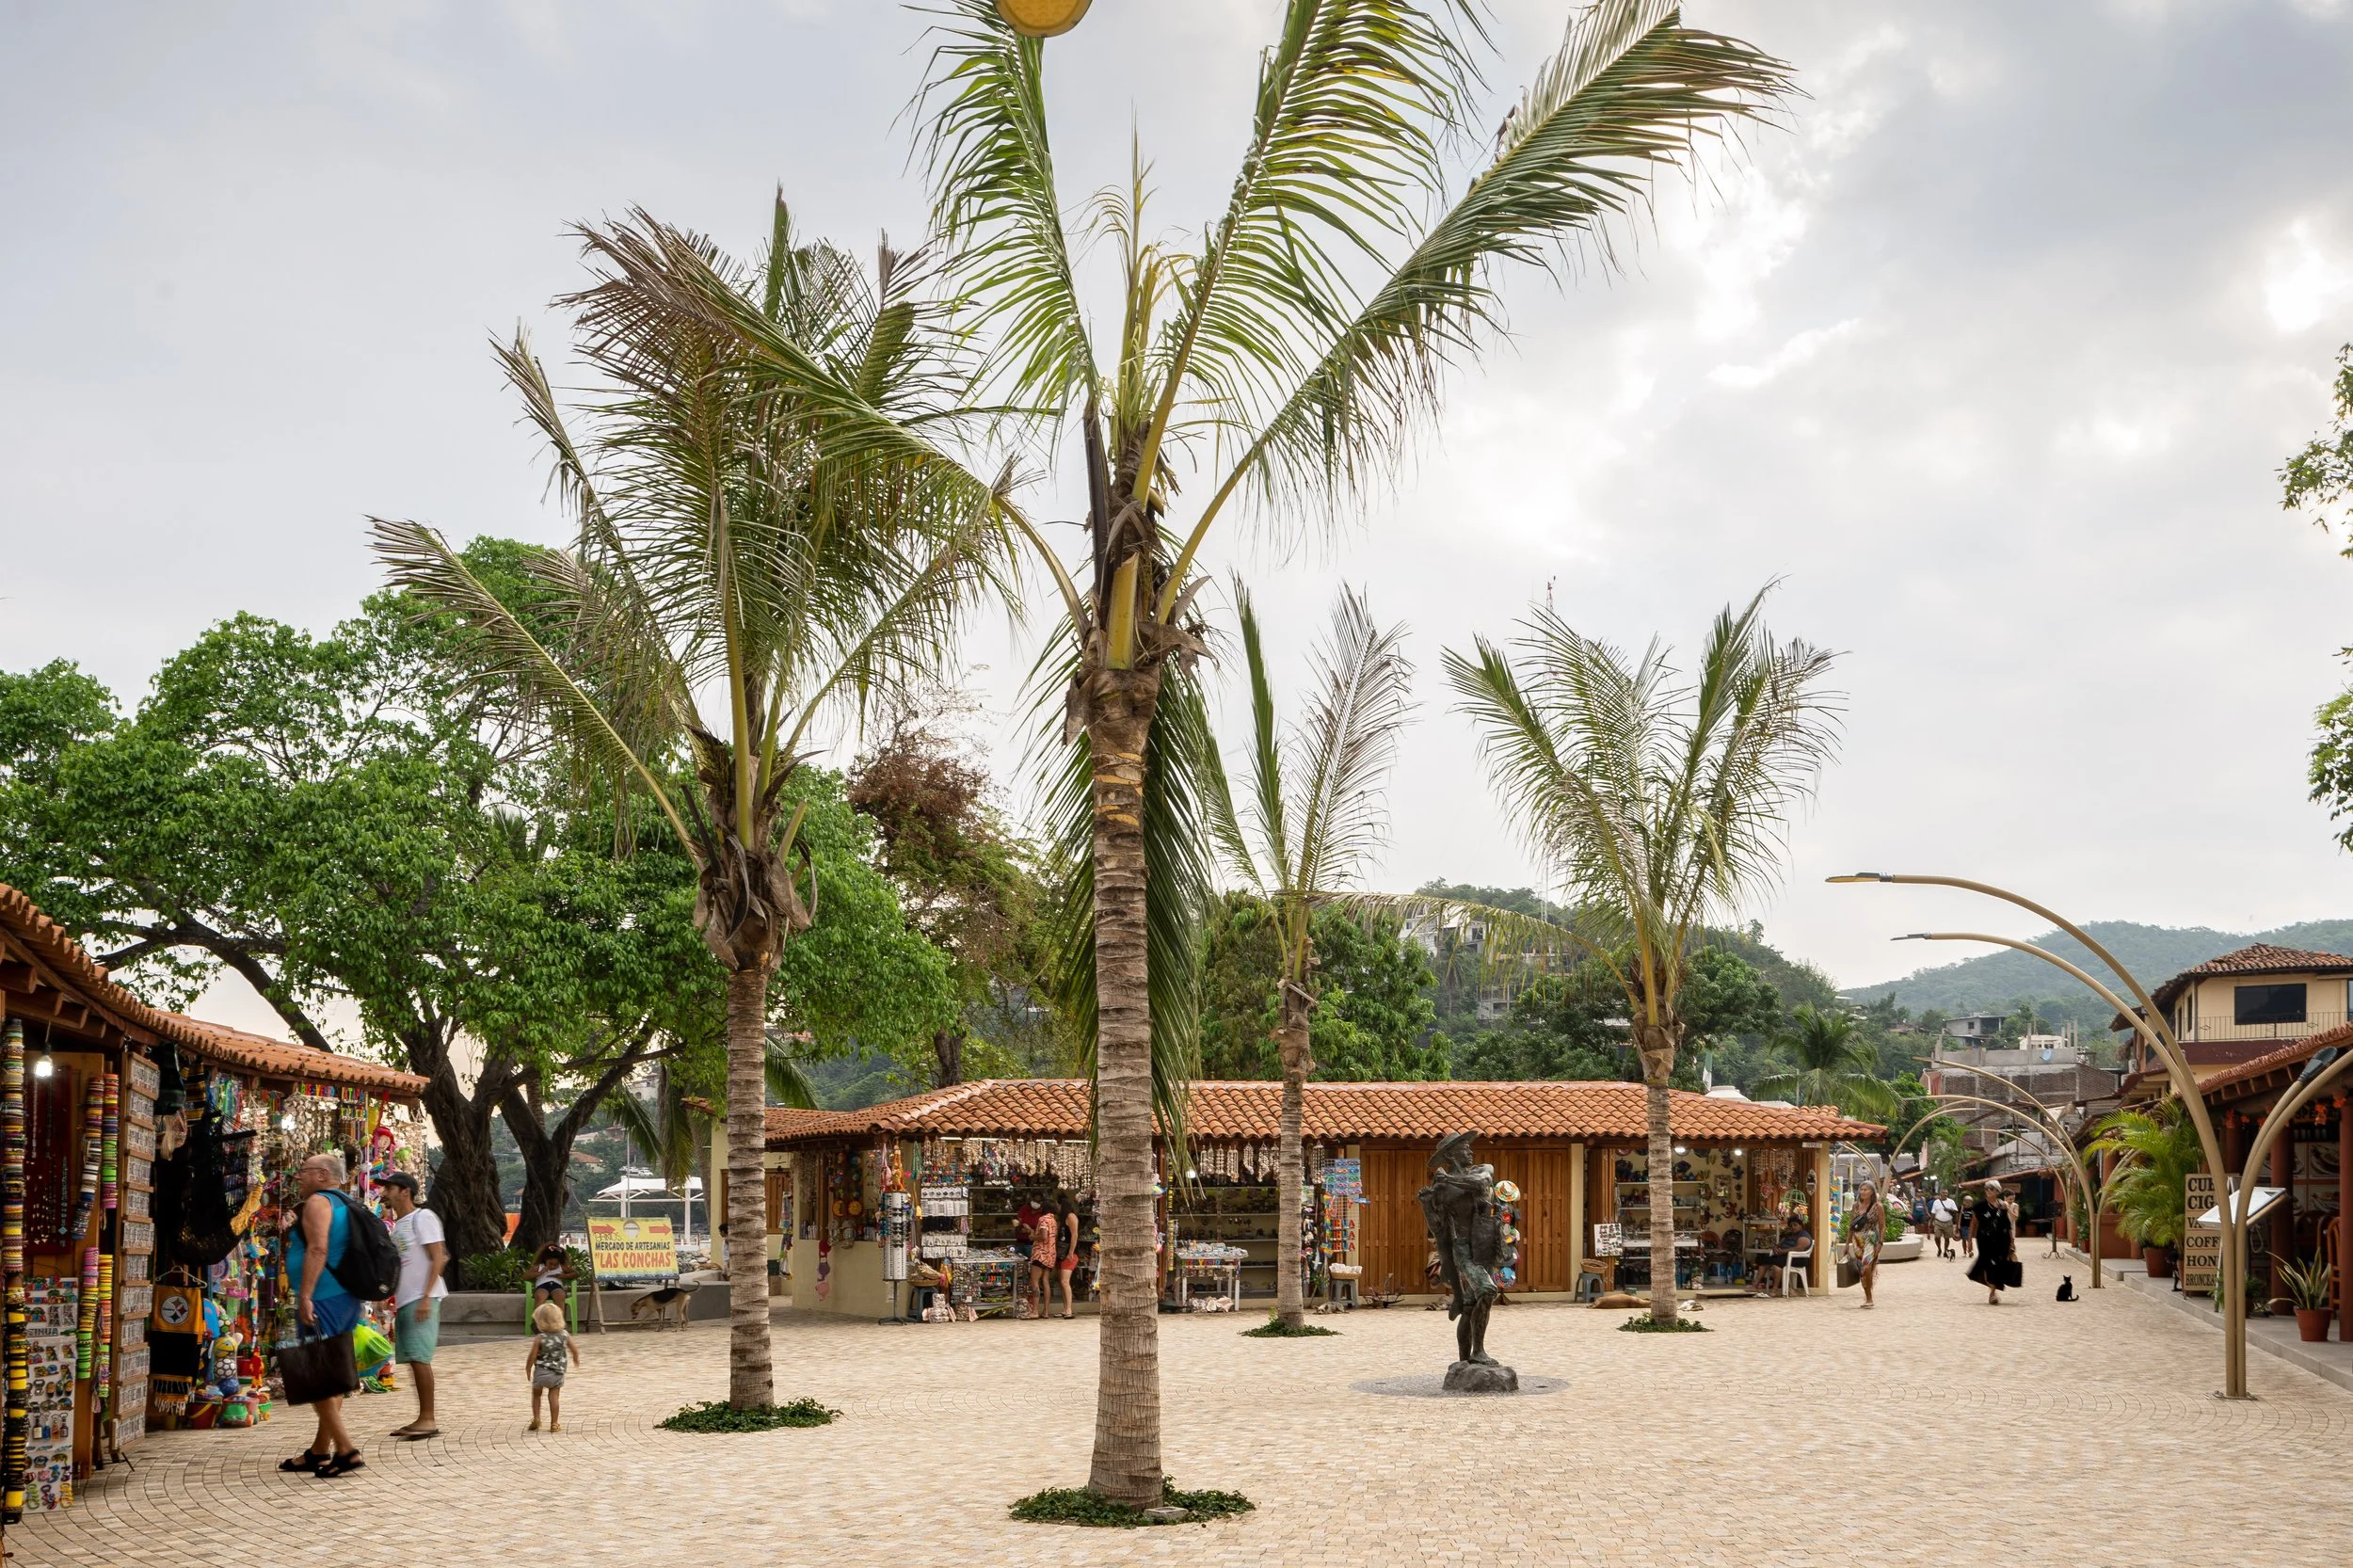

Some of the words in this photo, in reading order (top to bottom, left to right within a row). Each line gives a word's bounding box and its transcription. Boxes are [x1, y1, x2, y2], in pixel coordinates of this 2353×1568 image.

[2187, 1195, 2216, 1209] CIG
[595, 1241, 624, 1251] MERCADO
[626, 1241, 633, 1251] DE
[2186, 1236, 2220, 1248] COFF
[595, 1252, 619, 1269] "LAS
[622, 1251, 676, 1269] CONCHAS"
[2186, 1256, 2217, 1267] HON
